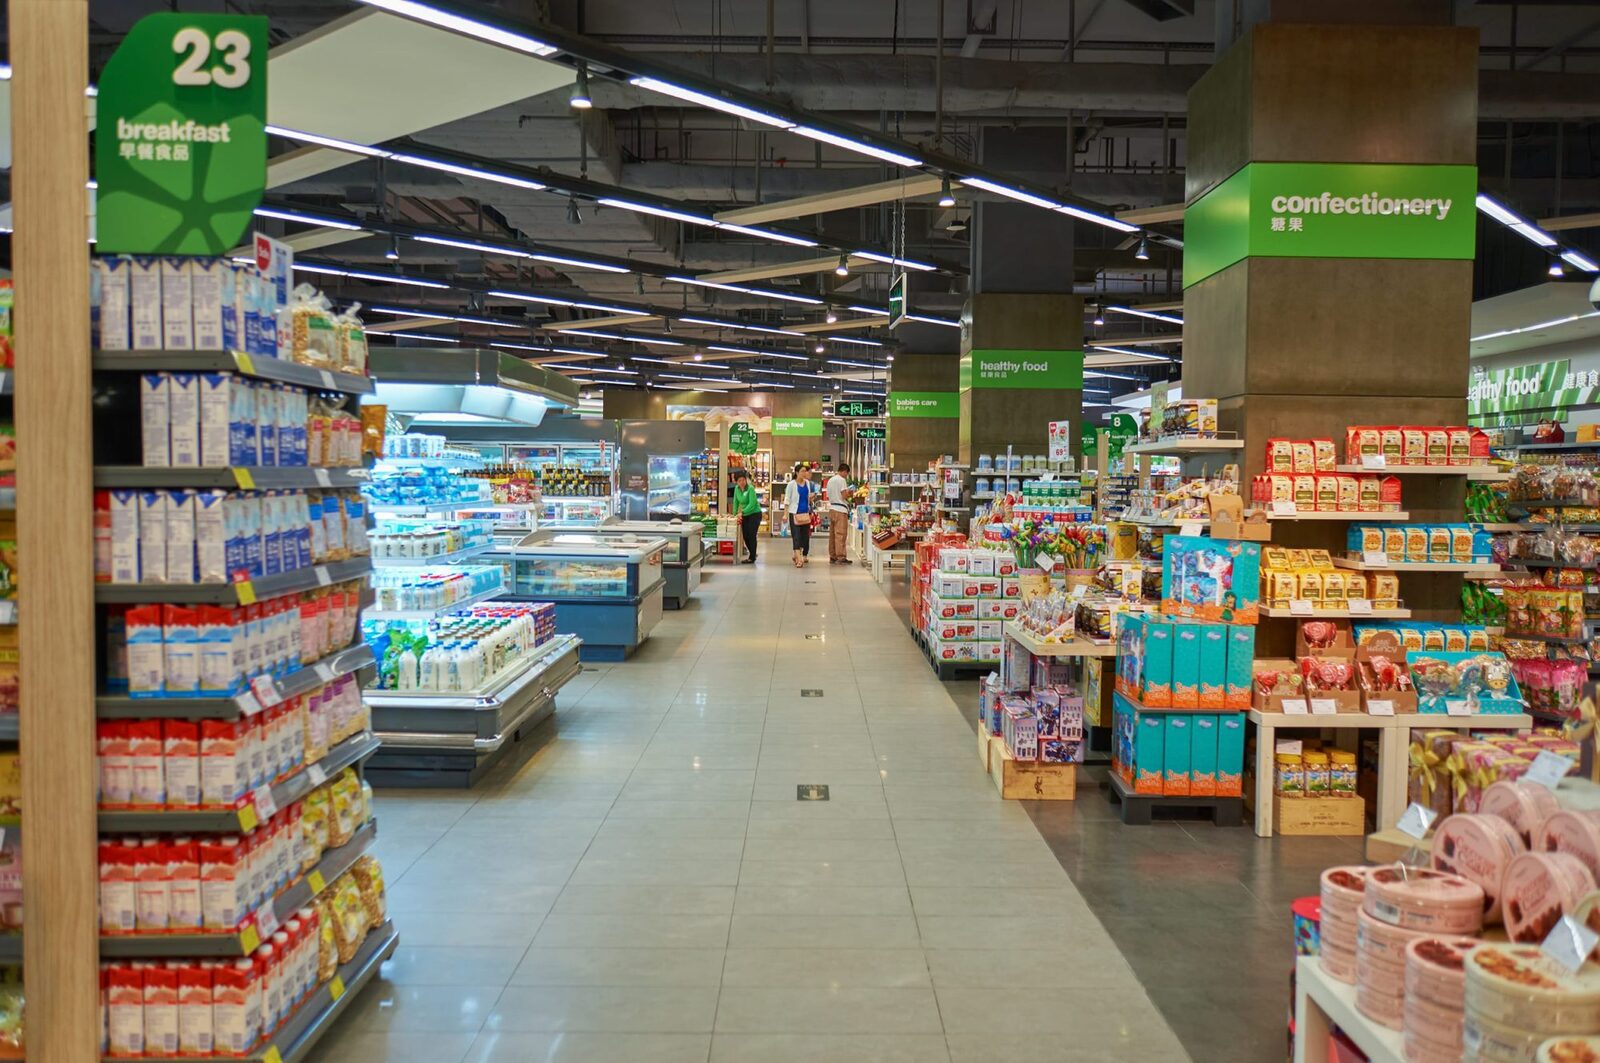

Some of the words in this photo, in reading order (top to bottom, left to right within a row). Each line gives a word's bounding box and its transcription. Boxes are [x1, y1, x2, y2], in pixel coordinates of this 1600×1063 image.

[172, 27, 251, 88] 23
[118, 118, 230, 142] breakfast
[119, 143, 189, 160] 早餐食品
[1271, 192, 1452, 220] confectionery
[980, 360, 1020, 373] healthy
[1022, 361, 1048, 371] food
[1506, 371, 1540, 397] food
[737, 423, 748, 431] 22
[1113, 416, 1121, 427] 8
